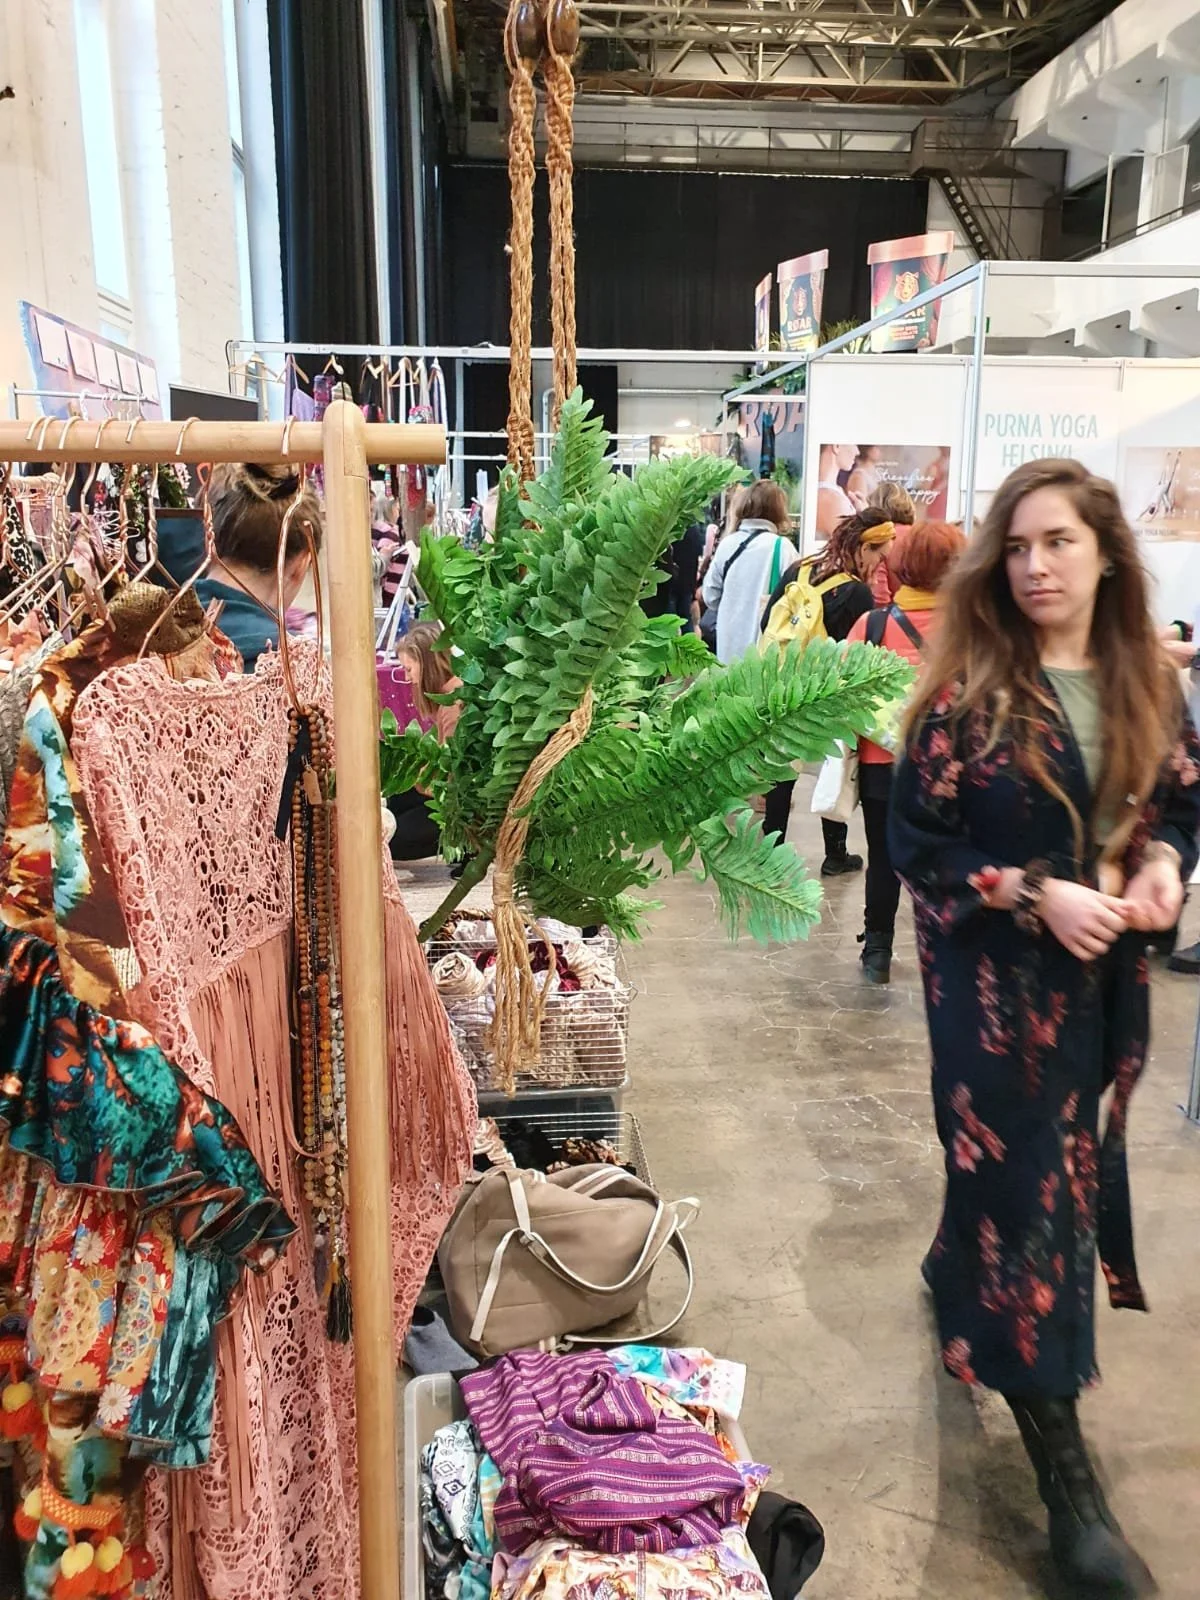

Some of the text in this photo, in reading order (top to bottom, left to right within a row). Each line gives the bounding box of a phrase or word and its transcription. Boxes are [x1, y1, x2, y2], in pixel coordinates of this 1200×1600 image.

[984, 413, 1099, 439] PURNA YOGA
[907, 488, 942, 505] appy
